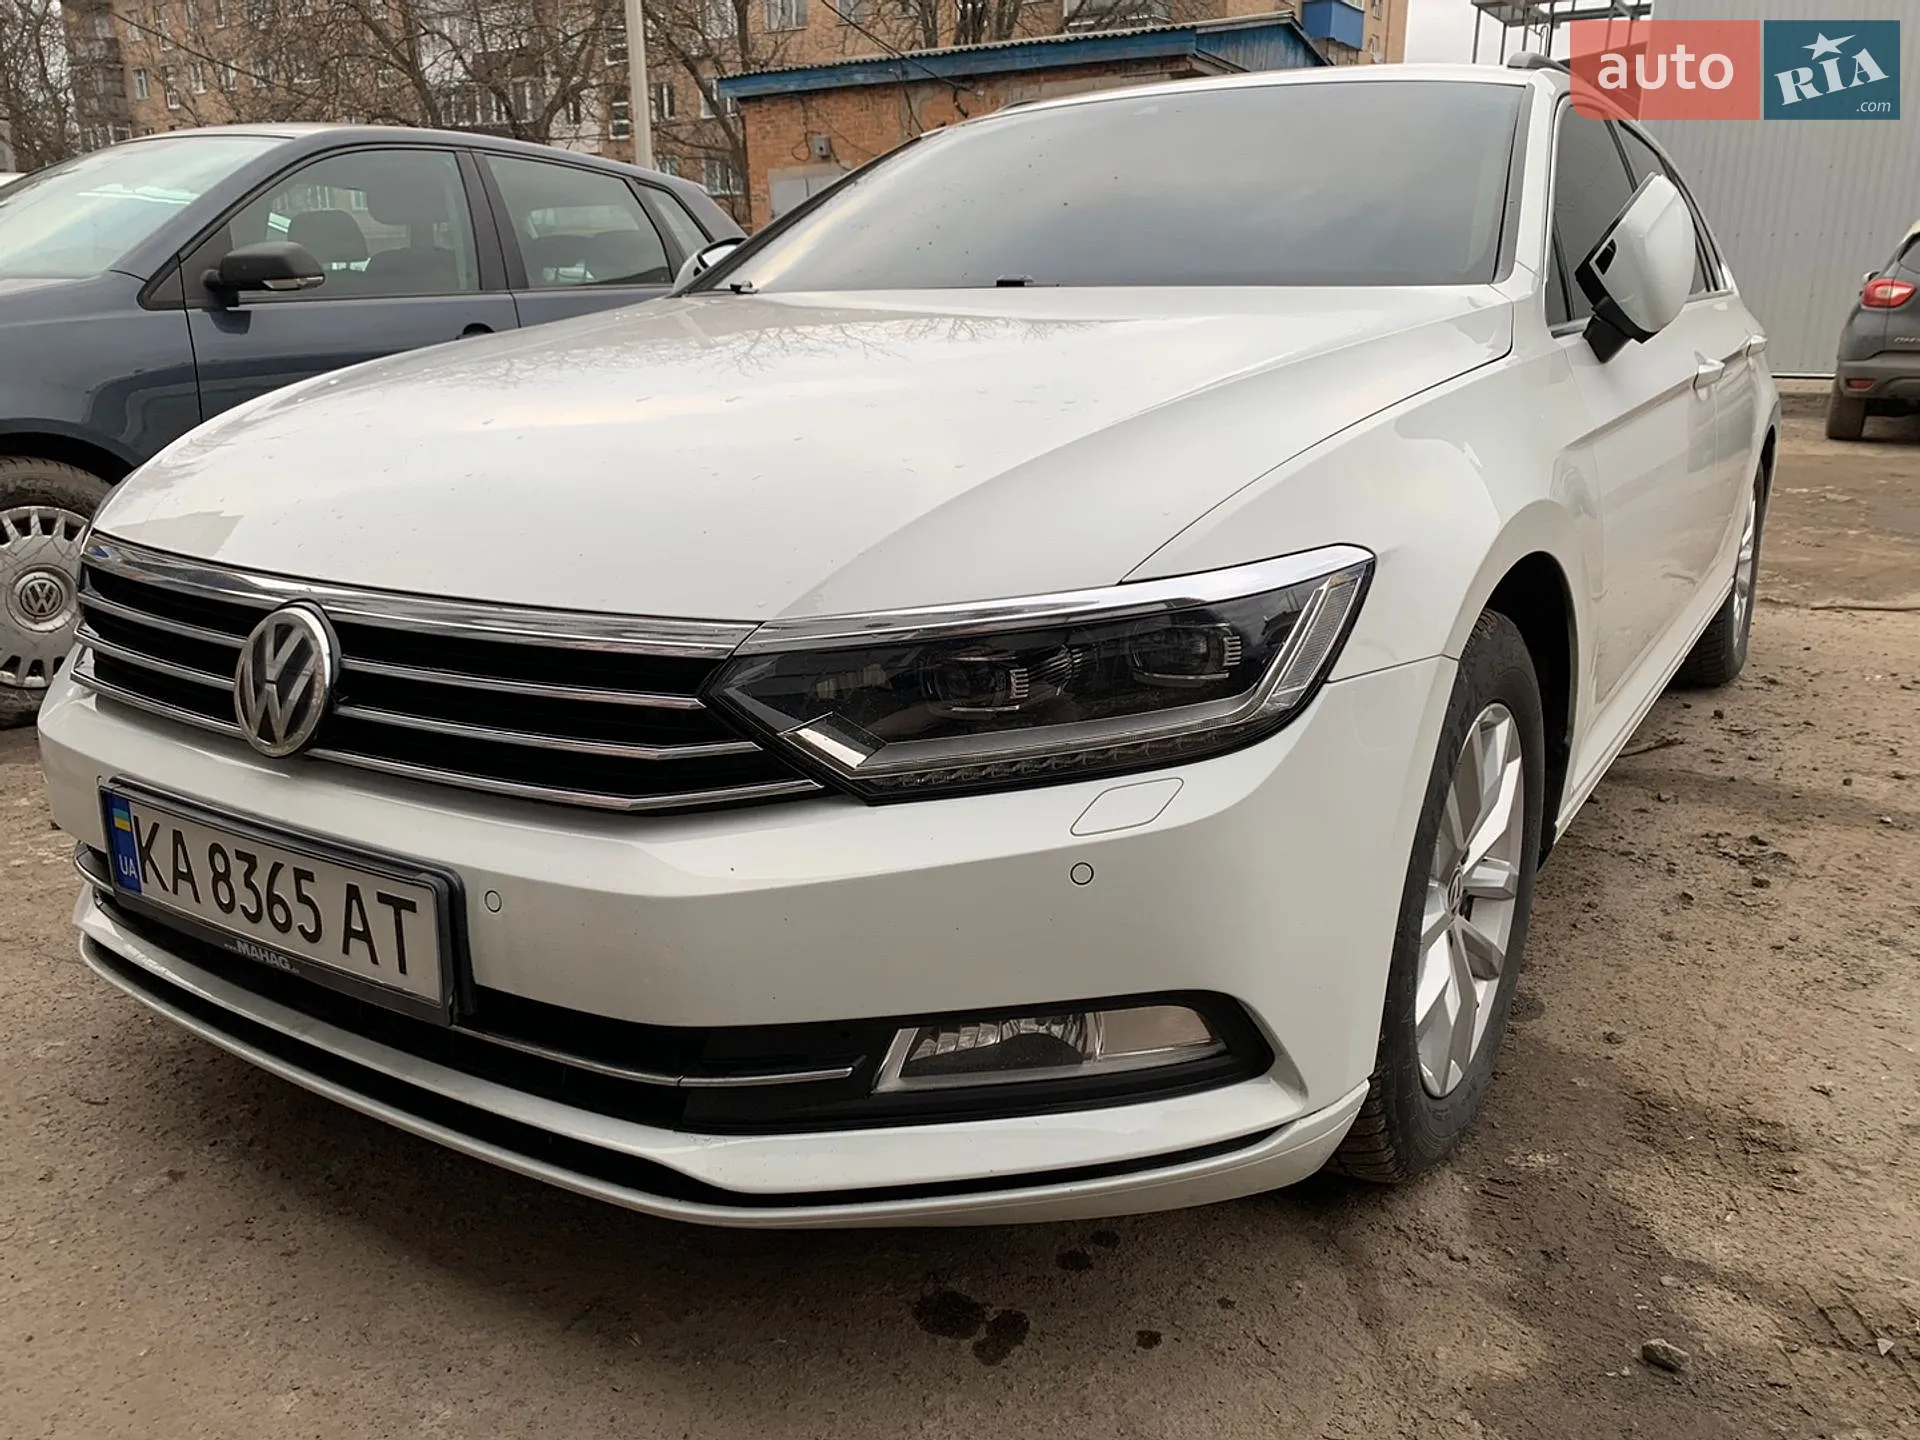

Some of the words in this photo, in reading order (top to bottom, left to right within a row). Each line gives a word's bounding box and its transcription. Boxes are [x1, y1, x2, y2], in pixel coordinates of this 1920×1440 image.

[118, 853, 138, 880] UA
[133, 816, 201, 904] KA
[208, 843, 323, 944] 8365
[342, 883, 417, 976] AT
